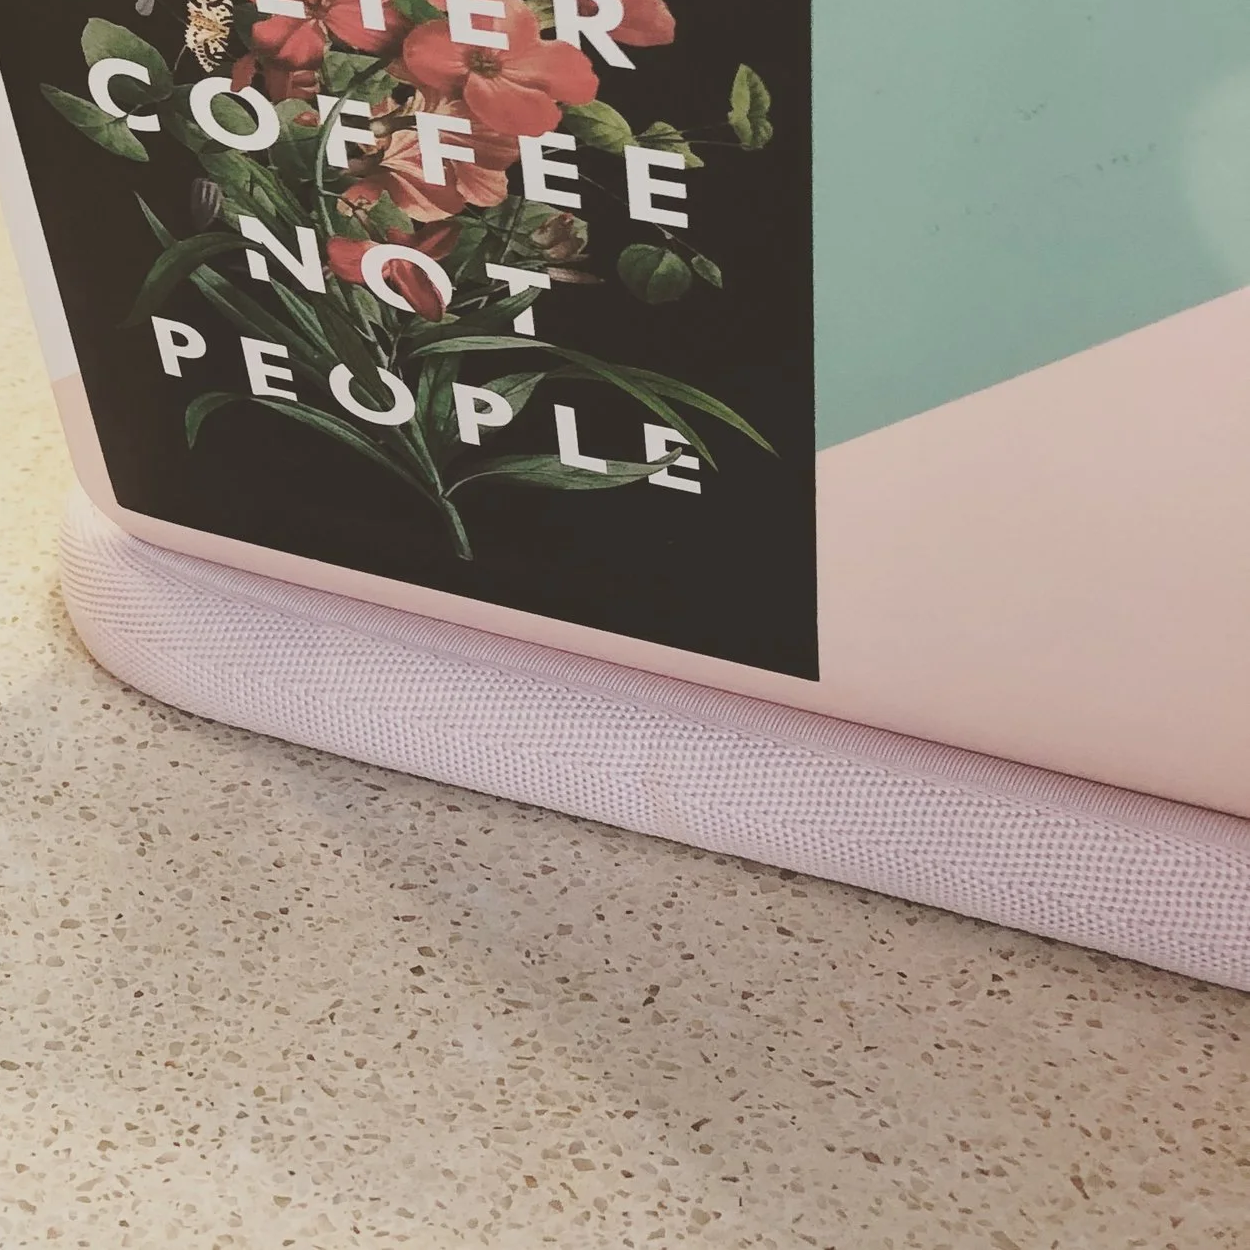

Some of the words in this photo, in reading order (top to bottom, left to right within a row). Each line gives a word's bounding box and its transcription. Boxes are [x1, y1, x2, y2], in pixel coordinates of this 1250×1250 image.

[88, 57, 688, 228] COFFEE
[238, 214, 551, 336] NOT
[151, 316, 701, 494] PEOPLE
